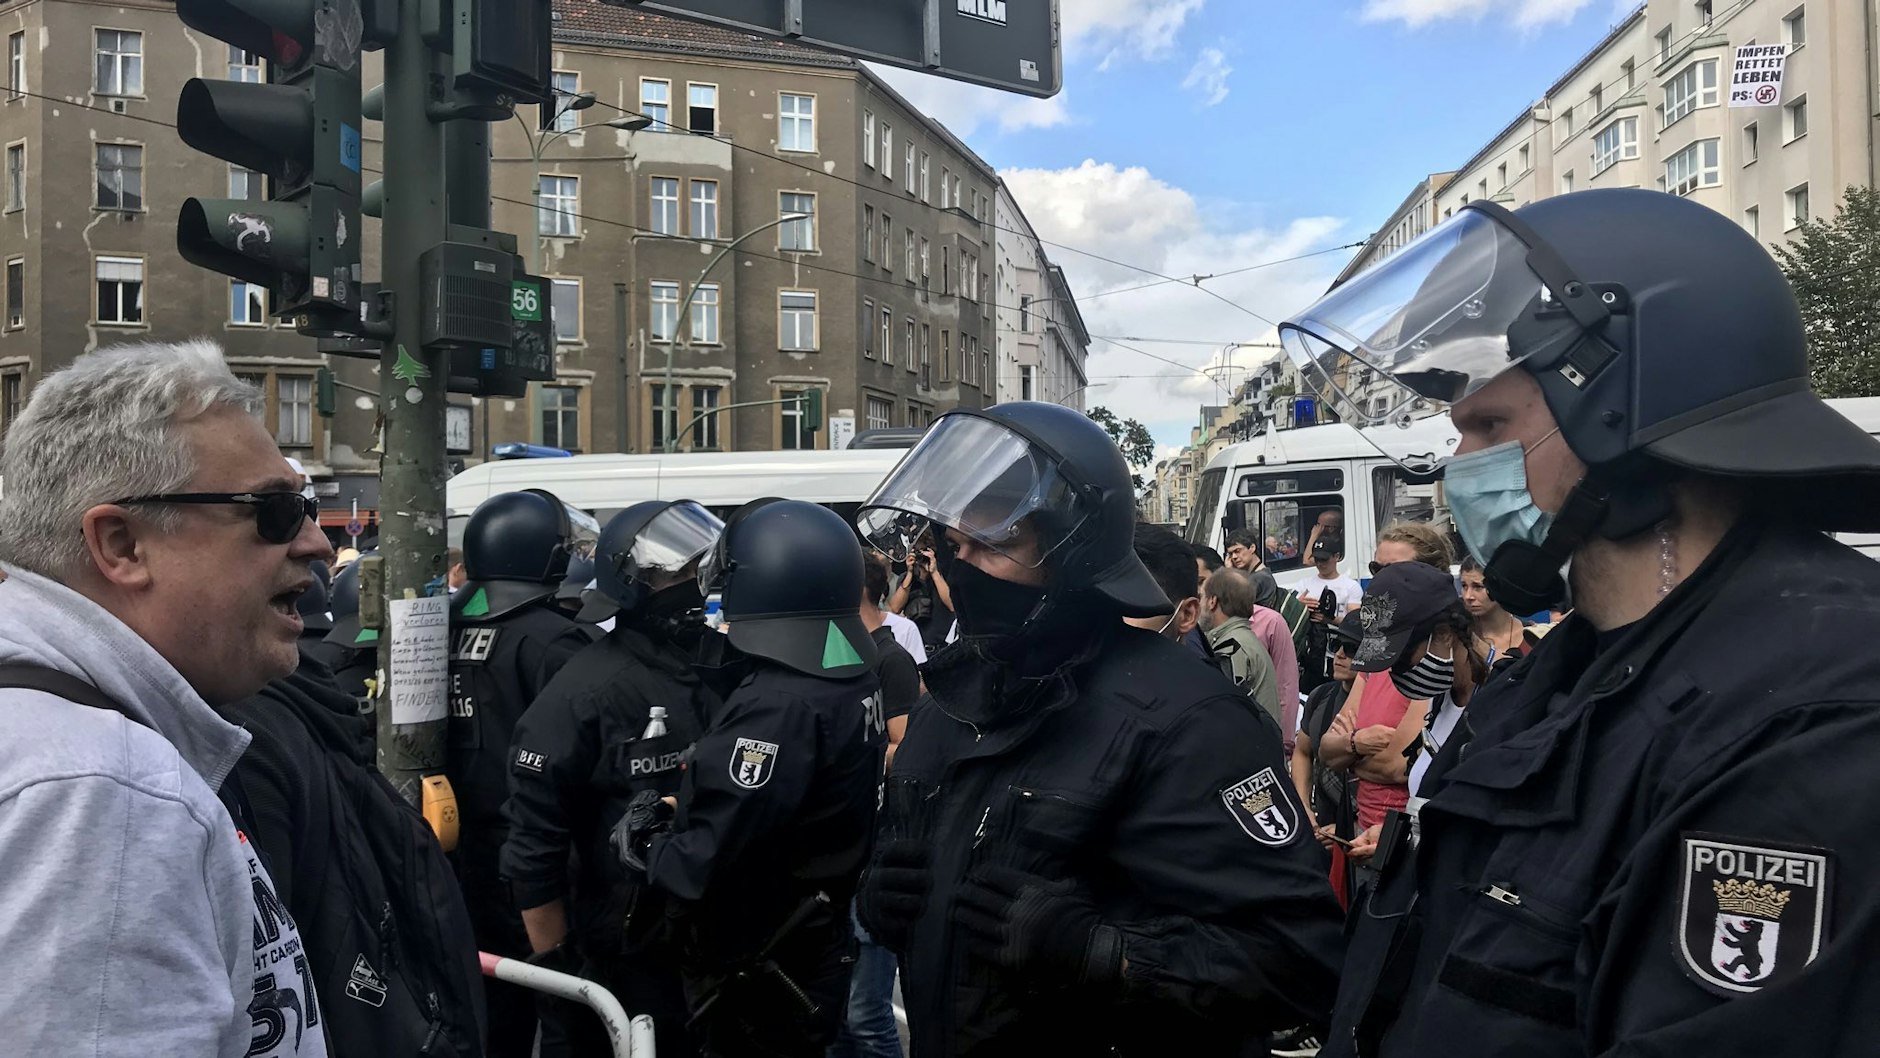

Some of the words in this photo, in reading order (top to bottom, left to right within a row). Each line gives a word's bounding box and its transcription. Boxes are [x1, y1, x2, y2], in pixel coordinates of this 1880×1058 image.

[1737, 46, 1785, 58] IMPFEN
[1735, 58, 1783, 70] RETTET
[1733, 71, 1781, 84] LEBEN
[1732, 91, 1752, 101] PS:
[512, 288, 538, 312] 56
[412, 602, 441, 613] RING
[450, 628, 496, 660] LIZEI
[738, 741, 775, 755] POLIZEI
[519, 750, 543, 767] BFE
[1225, 772, 1274, 806] POLIZEI
[1694, 847, 1815, 888] POLIZEI
